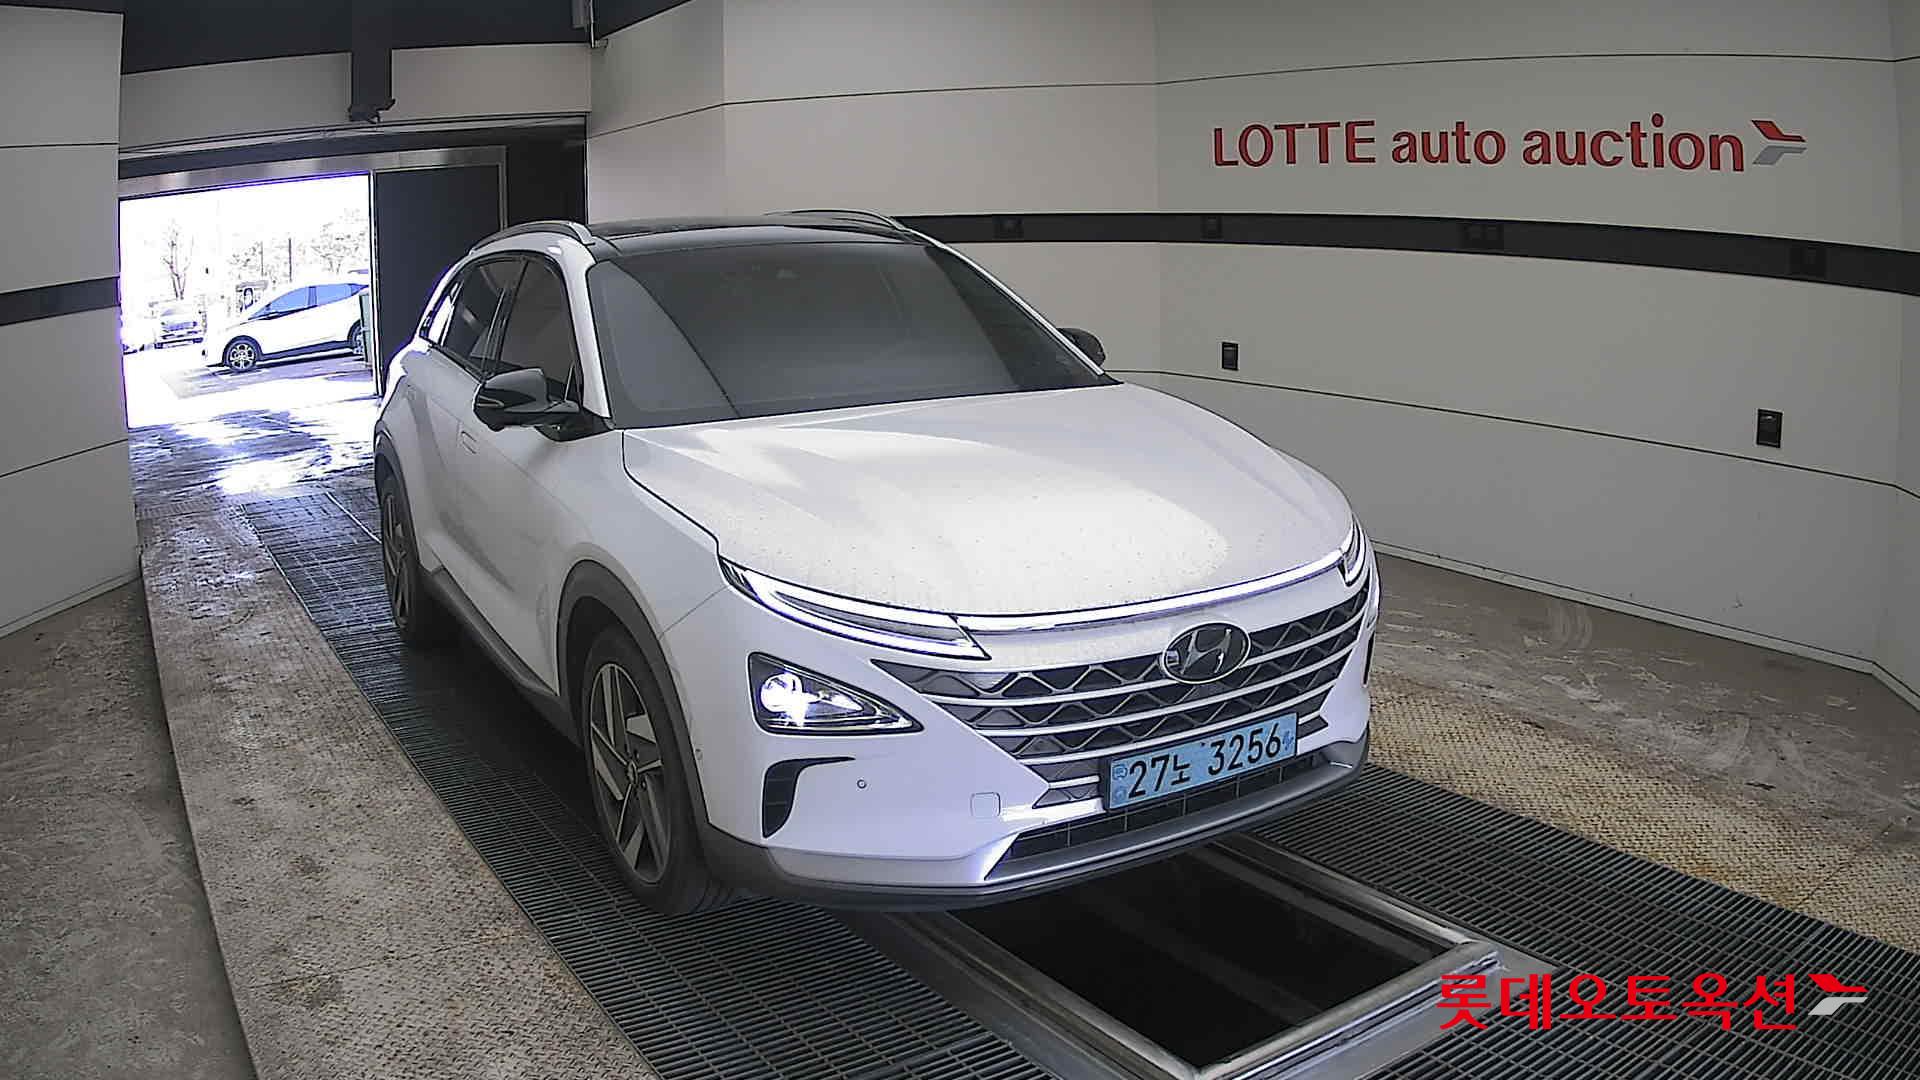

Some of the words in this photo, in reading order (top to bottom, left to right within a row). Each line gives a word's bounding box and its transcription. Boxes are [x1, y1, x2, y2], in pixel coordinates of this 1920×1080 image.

[1214, 120, 1376, 167] LOTTE
[1391, 121, 1507, 164] auto
[1522, 113, 1744, 171] auction
[1128, 754, 1190, 799] 27노
[1207, 722, 1281, 776] 3256
